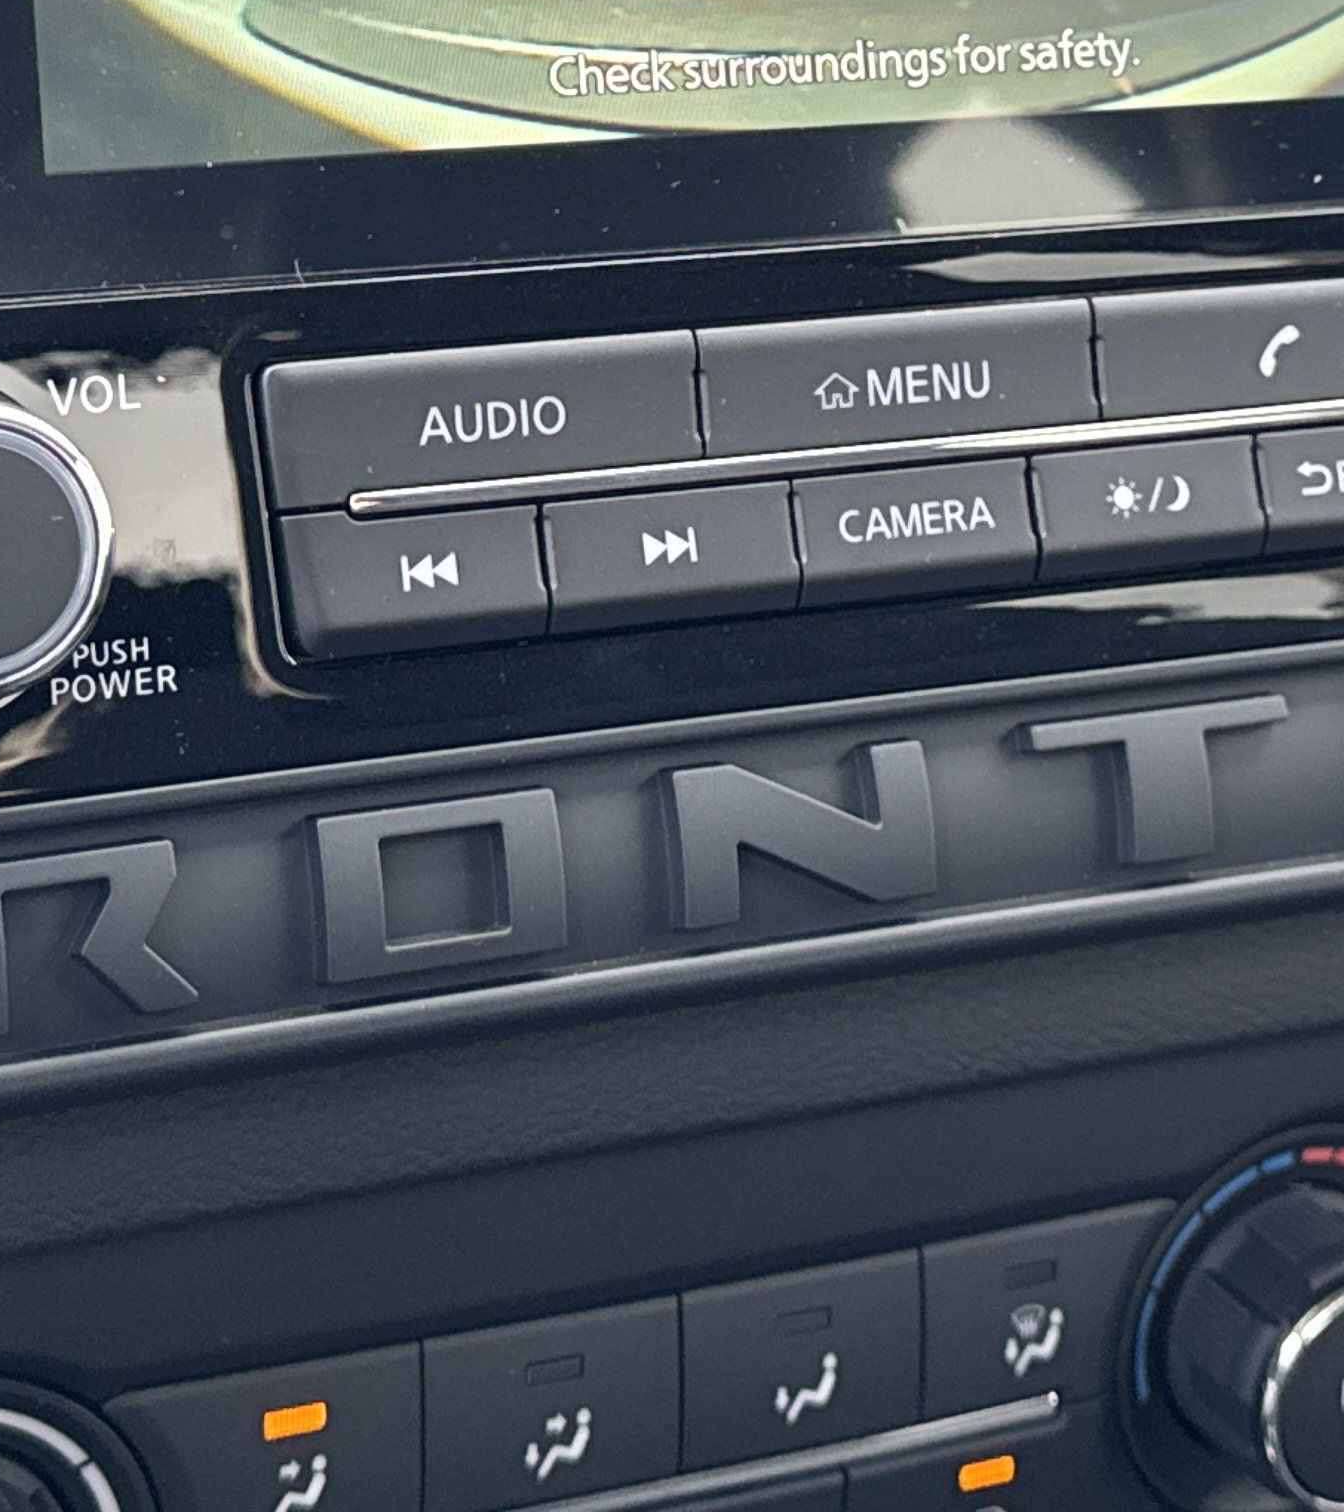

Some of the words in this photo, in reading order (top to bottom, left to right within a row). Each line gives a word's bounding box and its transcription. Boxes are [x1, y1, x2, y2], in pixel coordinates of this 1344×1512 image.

[547, 52, 675, 99] Check
[681, 38, 948, 90] surroundings
[953, 33, 1013, 75] for
[1018, 27, 1143, 75] safety.
[47, 373, 142, 416] VOL
[865, 360, 993, 407] MENU
[419, 395, 569, 446] AUDIO
[838, 496, 996, 544] CAMERA
[72, 636, 150, 669] PUSH
[50, 666, 178, 706] POWER
